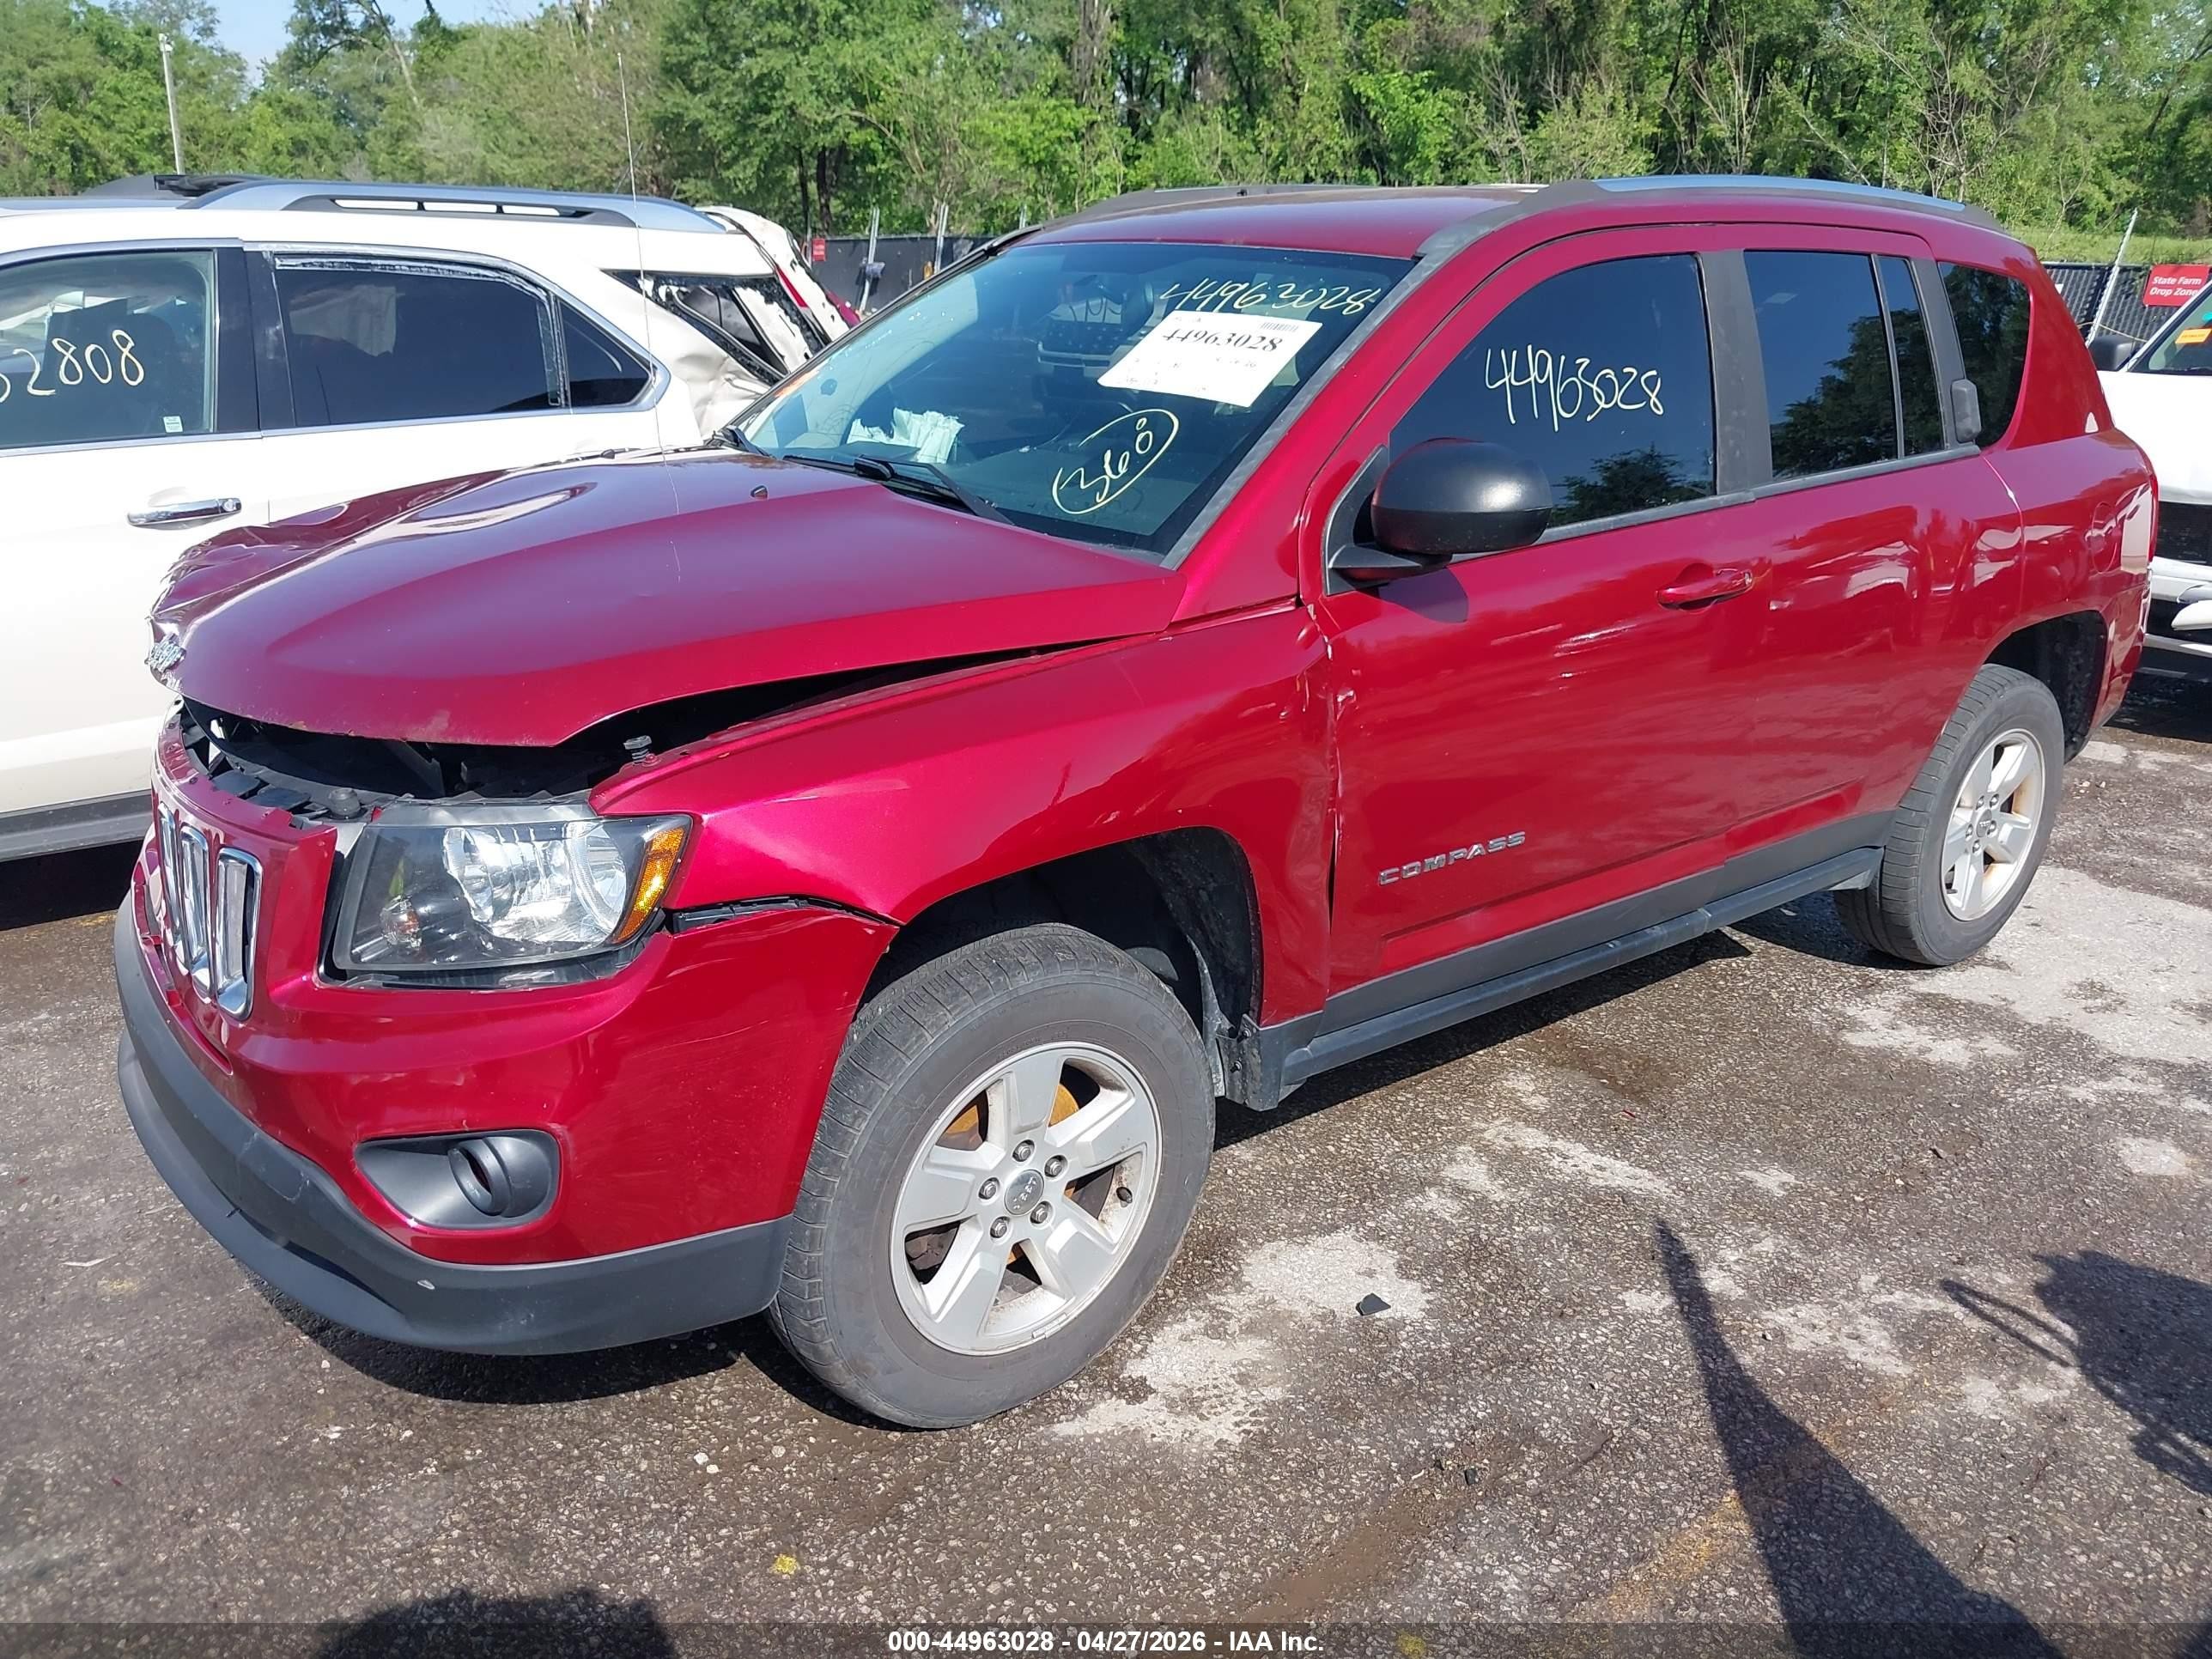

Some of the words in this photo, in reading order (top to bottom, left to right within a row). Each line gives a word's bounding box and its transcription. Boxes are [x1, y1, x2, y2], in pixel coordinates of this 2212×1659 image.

[2149, 287, 2172, 297] Drop
[2153, 276, 2177, 285] State
[2178, 276, 2202, 285] Farm
[1160, 277, 1382, 316] 44963028
[1163, 328, 1283, 352] 44963028
[1485, 343, 1664, 432] 44963028
[1378, 830, 1526, 885] COMPASS
